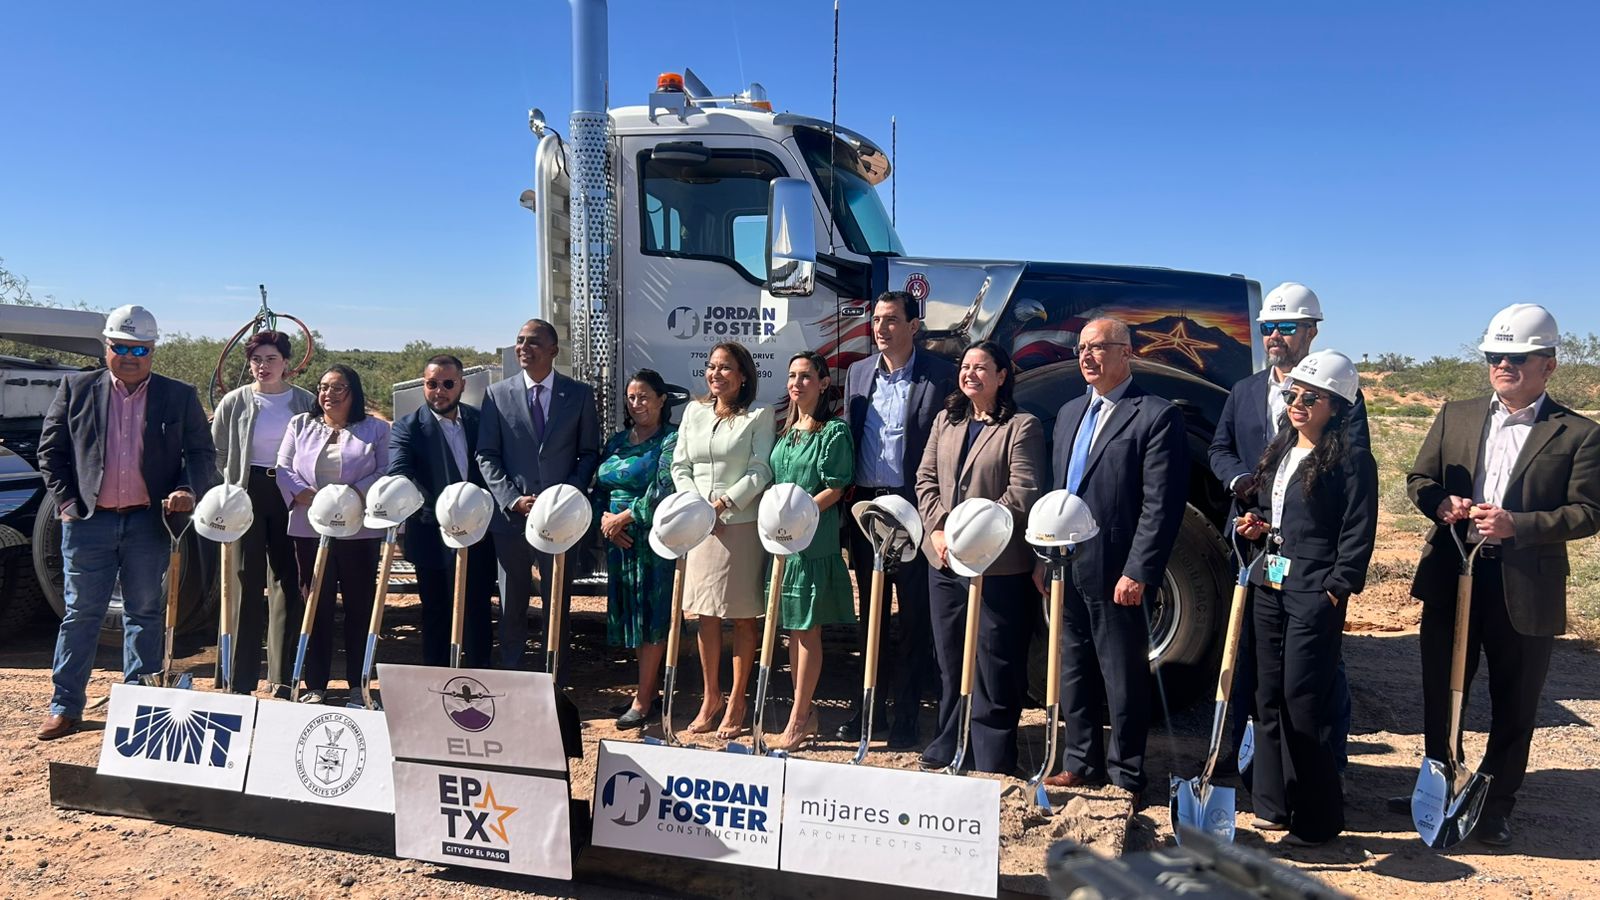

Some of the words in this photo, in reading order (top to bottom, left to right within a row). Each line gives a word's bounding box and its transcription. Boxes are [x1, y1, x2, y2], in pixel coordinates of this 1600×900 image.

[703, 321, 776, 336] FOSTER
[704, 306, 776, 321] JORDAN
[114, 704, 243, 768] JMT
[299, 714, 333, 746] DEPARTMENT
[343, 718, 364, 751] COMMERCE
[446, 737, 504, 758] ELP
[297, 759, 309, 784] UNITED
[308, 783, 330, 796] STATES
[340, 766, 362, 792] AMERICA
[438, 773, 482, 807] EP
[661, 775, 769, 808] JORDAN
[440, 807, 491, 843] TX
[658, 799, 768, 832] FOSTER
[800, 798, 891, 824] mijares
[918, 812, 982, 835] mora
[656, 822, 769, 844] CONSTRUCTION
[799, 827, 923, 851] ARCHITECTS
[445, 845, 463, 855] CITY
[463, 847, 475, 856] OF
[475, 848, 485, 857] EL
[486, 850, 506, 860] PASO
